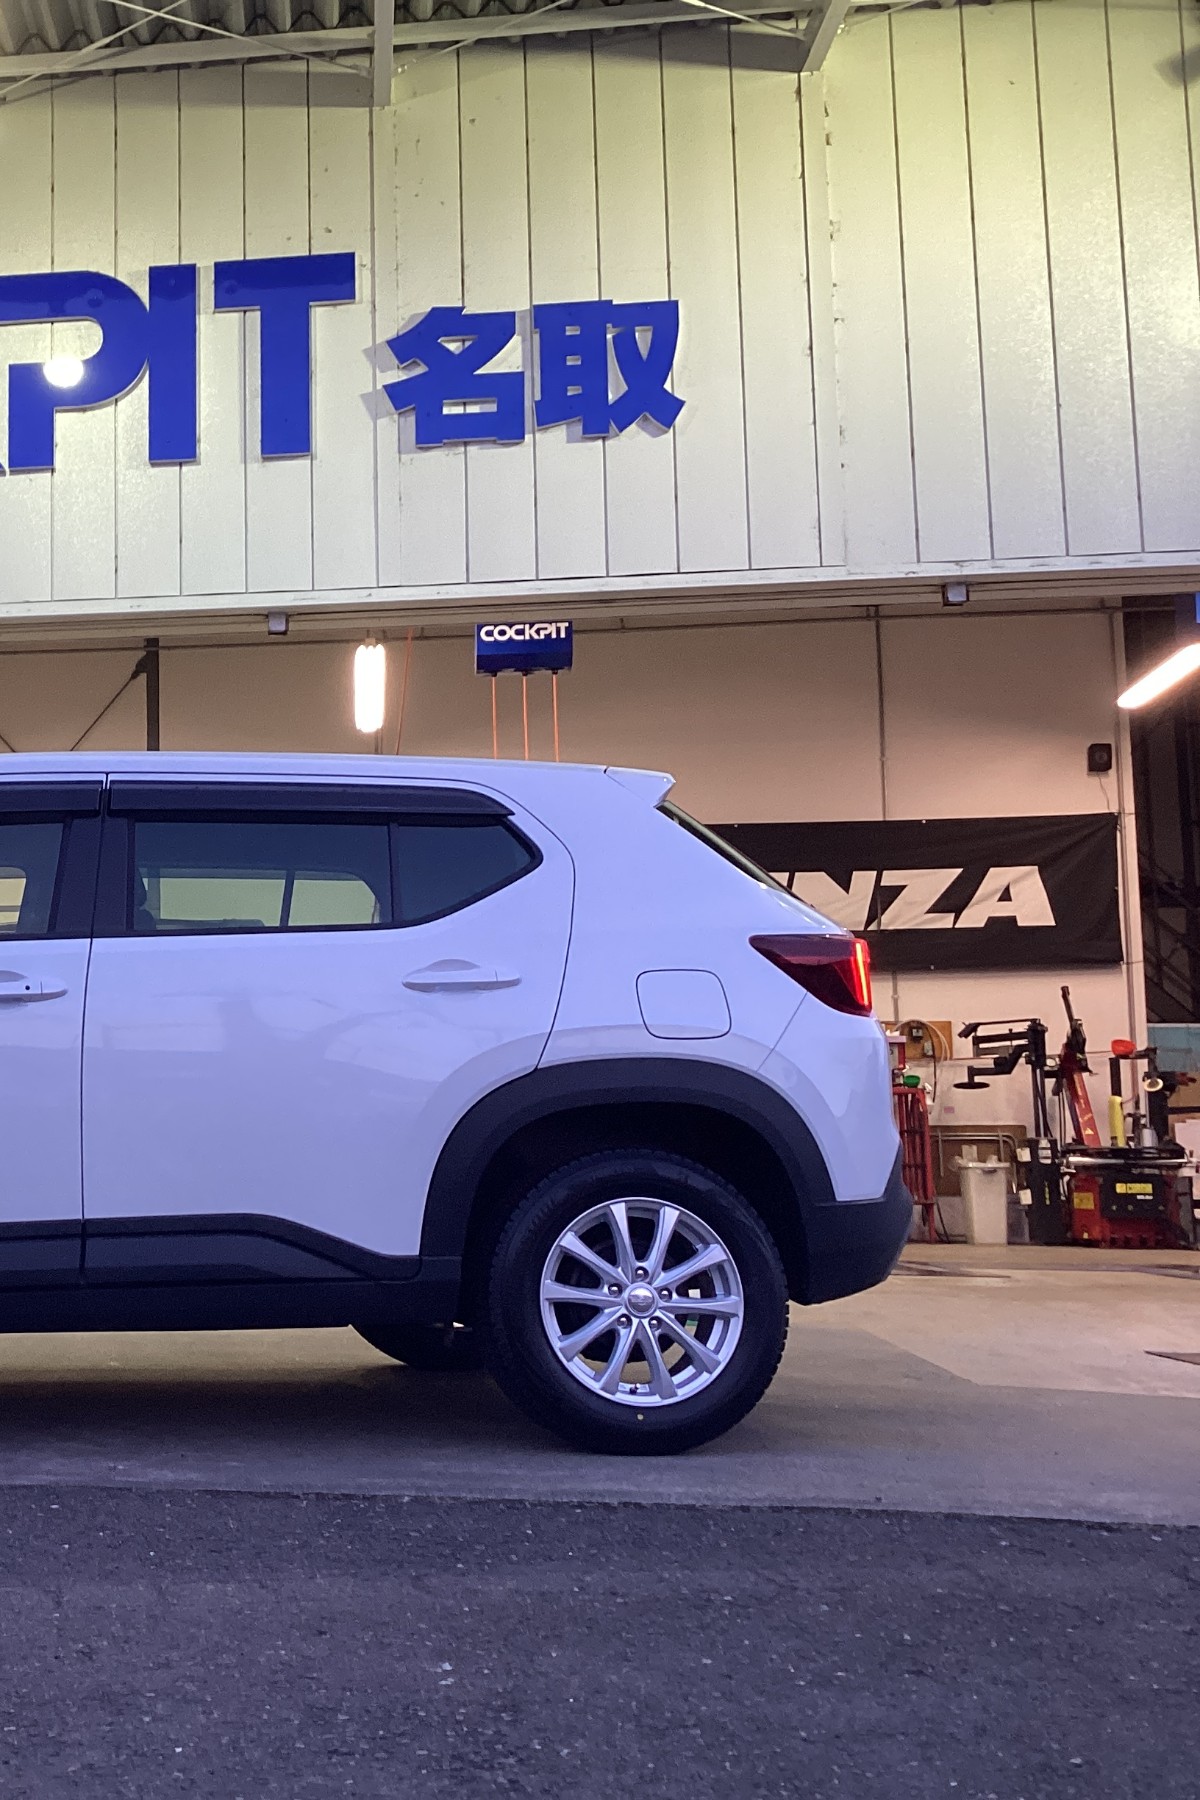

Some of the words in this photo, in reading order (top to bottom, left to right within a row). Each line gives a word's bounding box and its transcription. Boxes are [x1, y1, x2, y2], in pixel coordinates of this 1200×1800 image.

[383, 300, 685, 448] 名取
[480, 622, 569, 642] COCKPIT
[768, 865, 1056, 931] NZA
